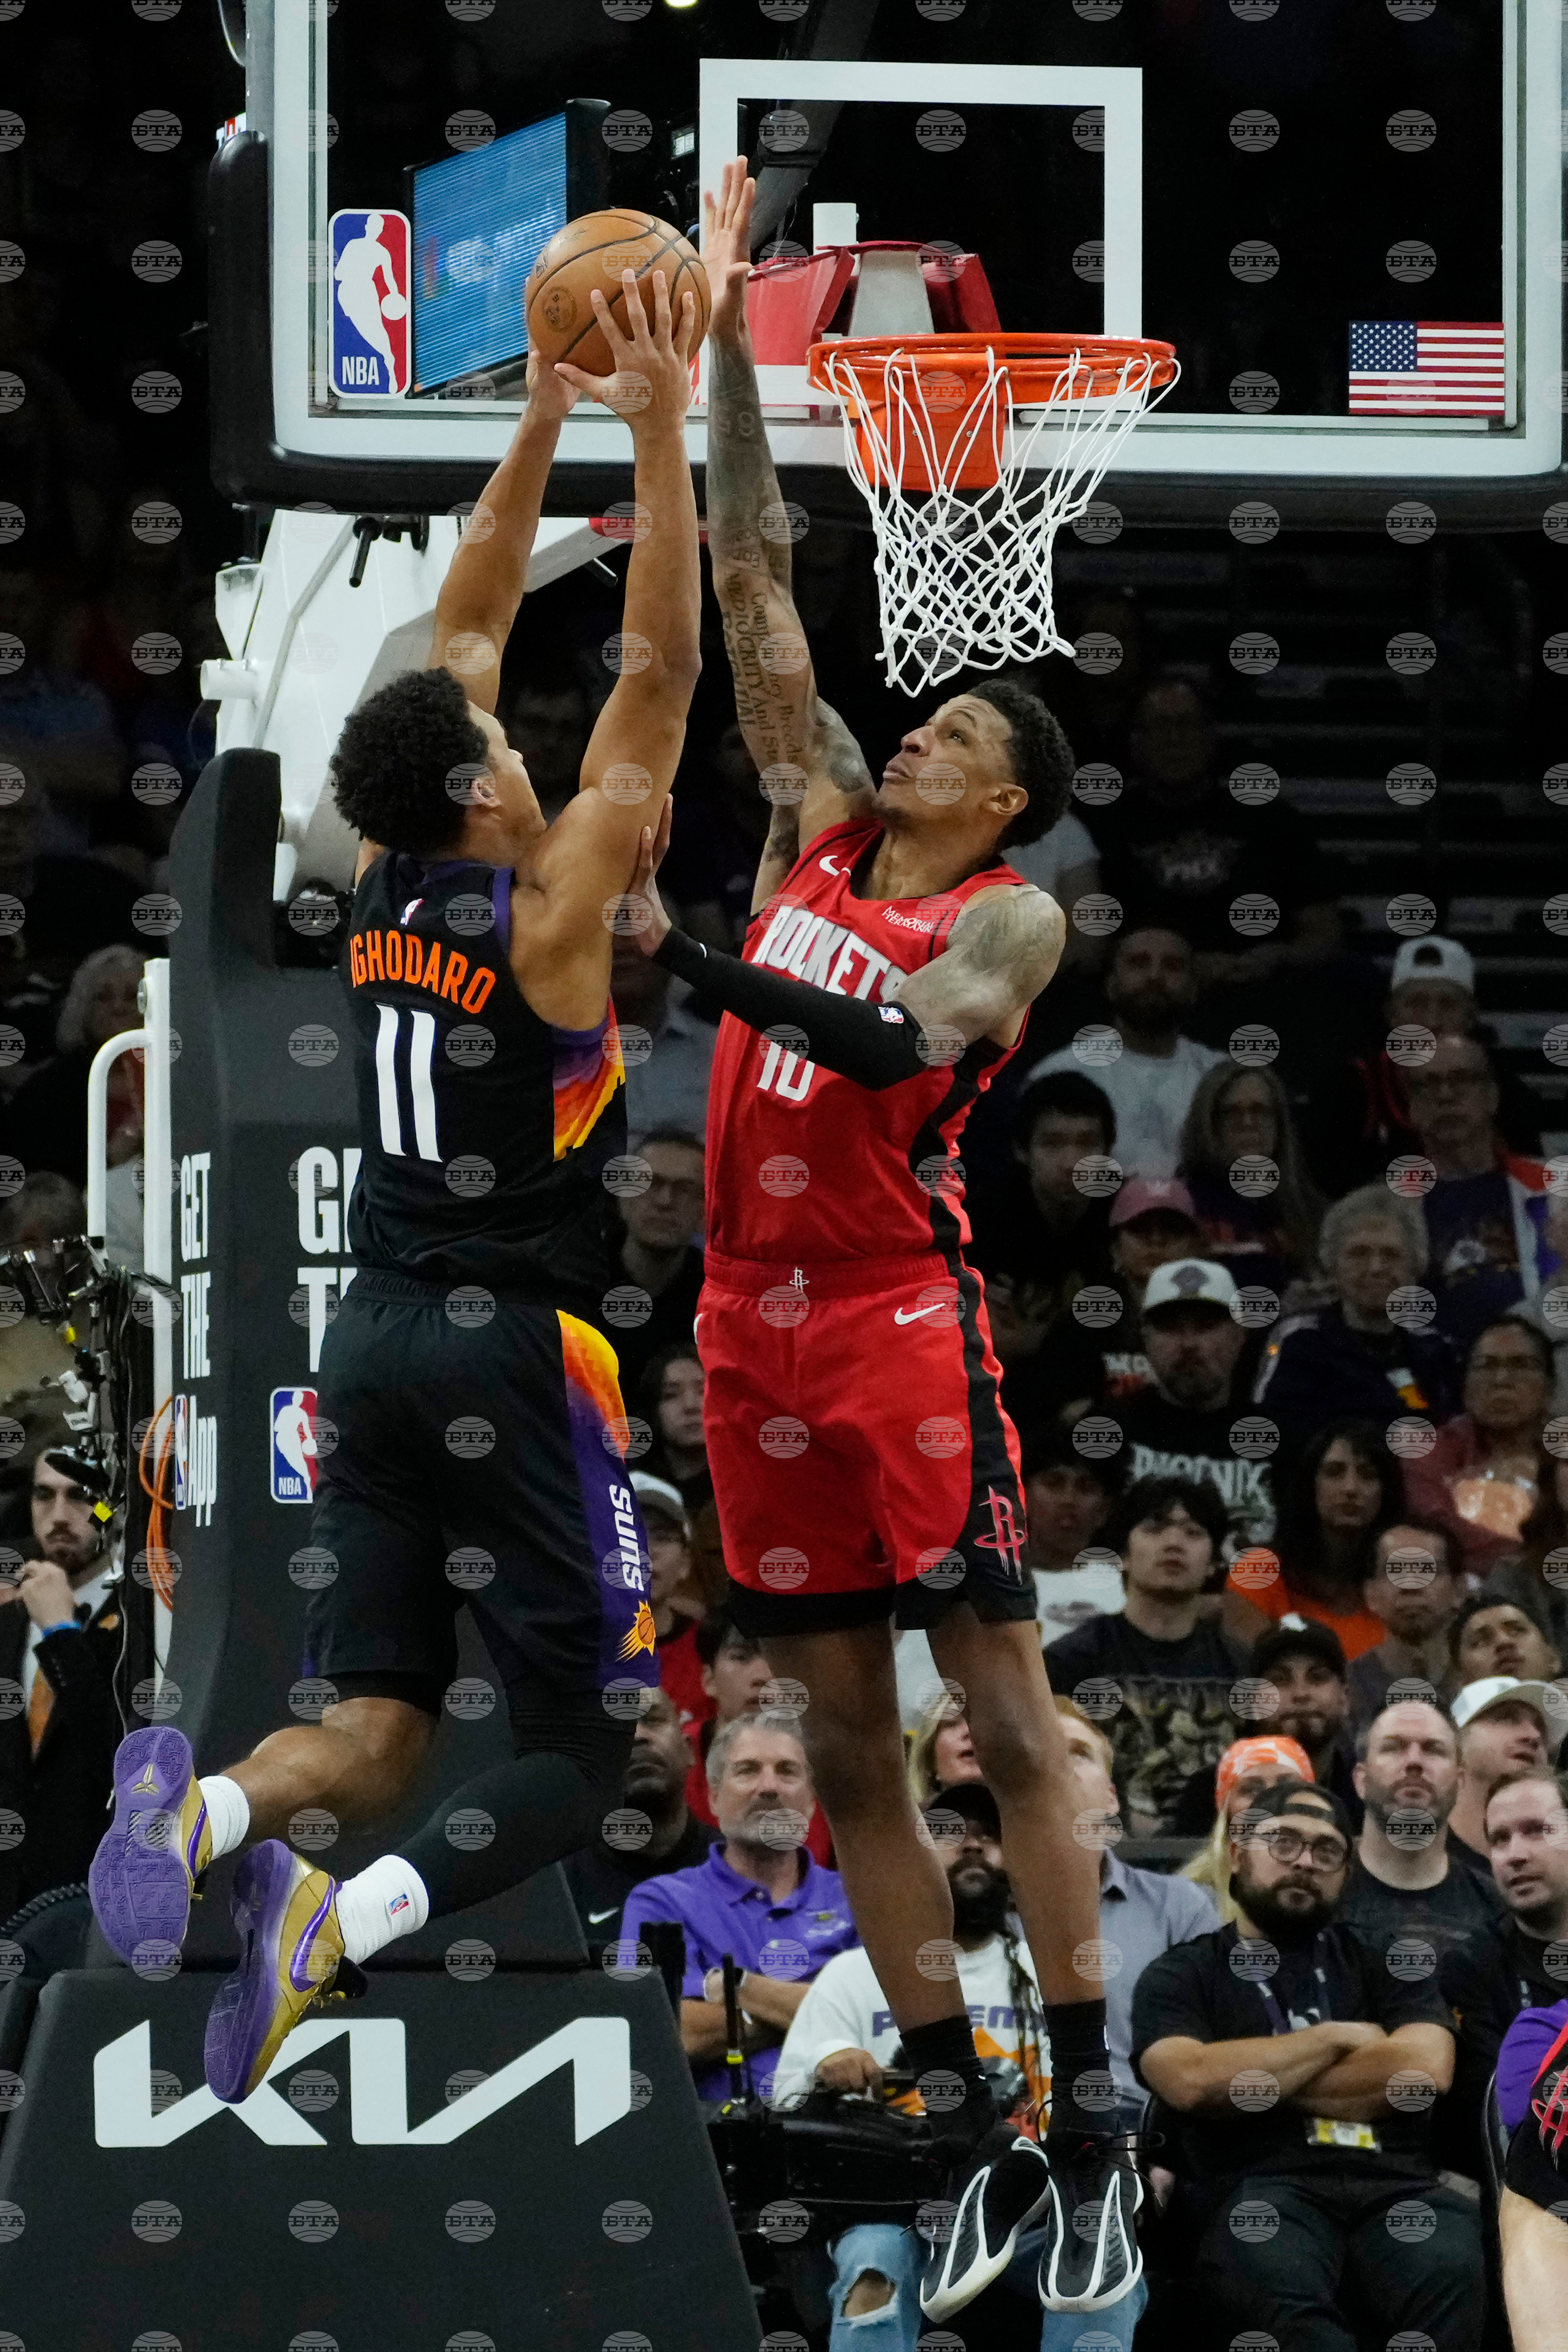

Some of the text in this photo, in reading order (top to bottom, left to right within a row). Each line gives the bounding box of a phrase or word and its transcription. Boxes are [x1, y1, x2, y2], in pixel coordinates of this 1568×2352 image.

[342, 356, 379, 385] NBA
[350, 929, 496, 1014] IGHODARO
[375, 1002, 443, 1162] 11
[757, 1041, 815, 1102] 10
[181, 1152, 211, 1262] GET
[181, 1271, 211, 1380] THE
[188, 1395, 217, 1527] App
[278, 1477, 302, 1496] NBA
[609, 1484, 644, 1592] SUNS
[94, 2016, 631, 2148] KIA
